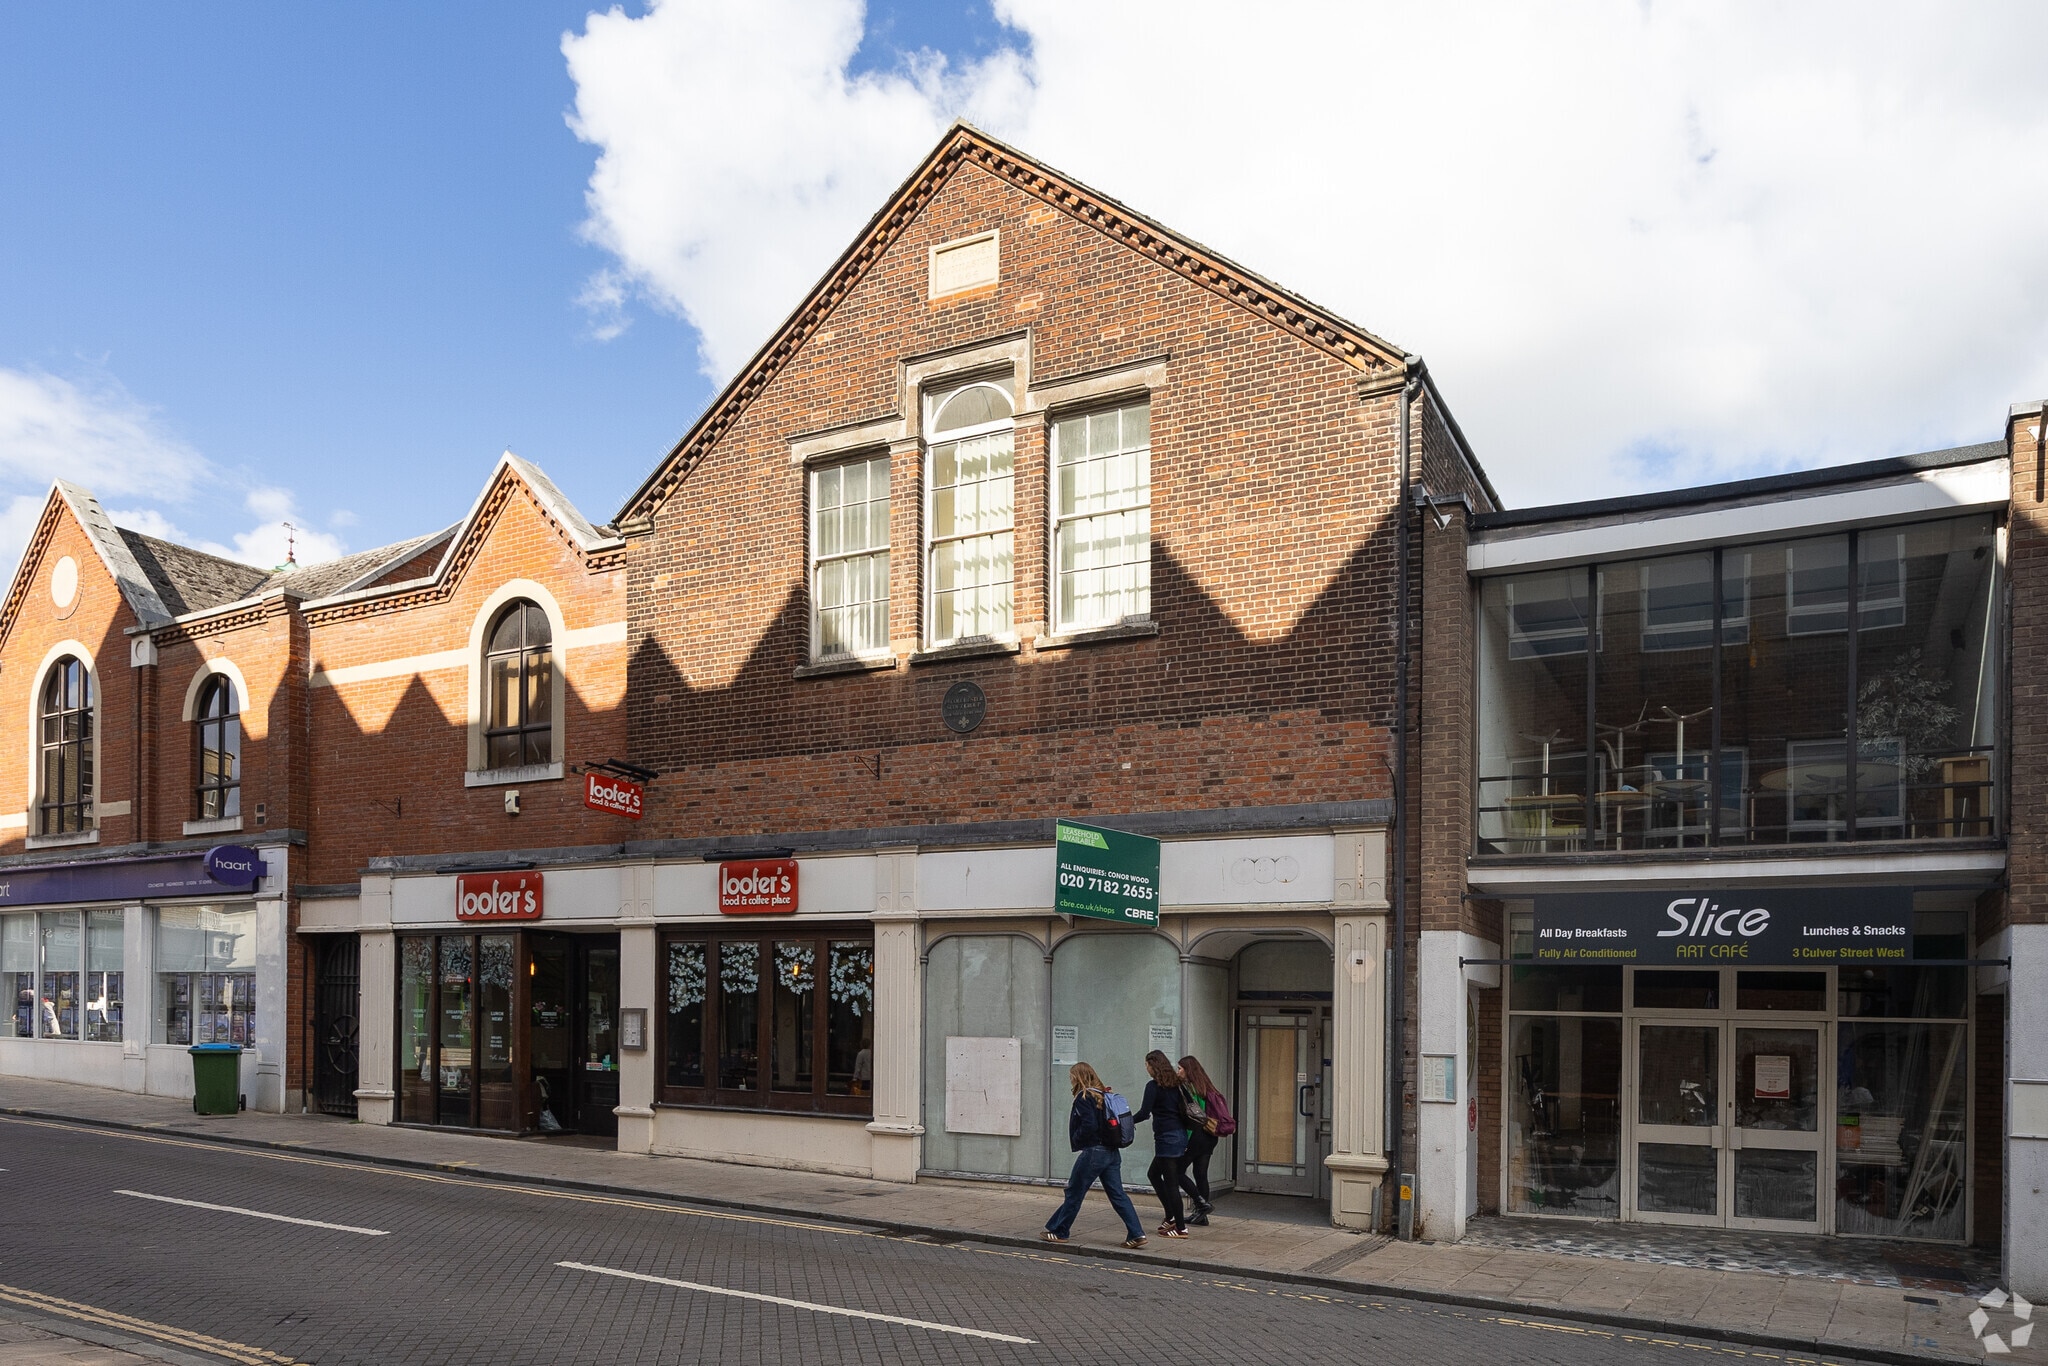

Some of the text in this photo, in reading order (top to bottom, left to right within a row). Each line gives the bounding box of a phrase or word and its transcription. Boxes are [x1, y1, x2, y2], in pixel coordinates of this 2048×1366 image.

[590, 776, 640, 807] loofer's
[589, 796, 604, 805] food
[626, 805, 640, 814] place
[1062, 828, 1099, 840] LEASEHOLD
[1062, 834, 1096, 847] AVAILABLE
[215, 858, 252, 872] haart
[1061, 862, 1149, 884] ALL ENQUIRIES: CONOR WOOD
[722, 867, 791, 895] loofer's
[1060, 872, 1153, 900] 020 7182 2655
[458, 879, 537, 915] loofer's
[722, 894, 791, 906] food & coffee place
[1060, 899, 1115, 915] cbre.co.uk/shops
[1124, 908, 1154, 920] CBRE
[1656, 897, 1771, 937] Slice
[1540, 928, 1627, 940] All Day Breakfasts
[1803, 925, 1906, 936] Lunches & Snacks
[1539, 948, 1637, 959] Fully Air Conditioned
[1676, 941, 1748, 958] ART CAFÉ
[1792, 947, 1905, 958] 3 Culver Street West
